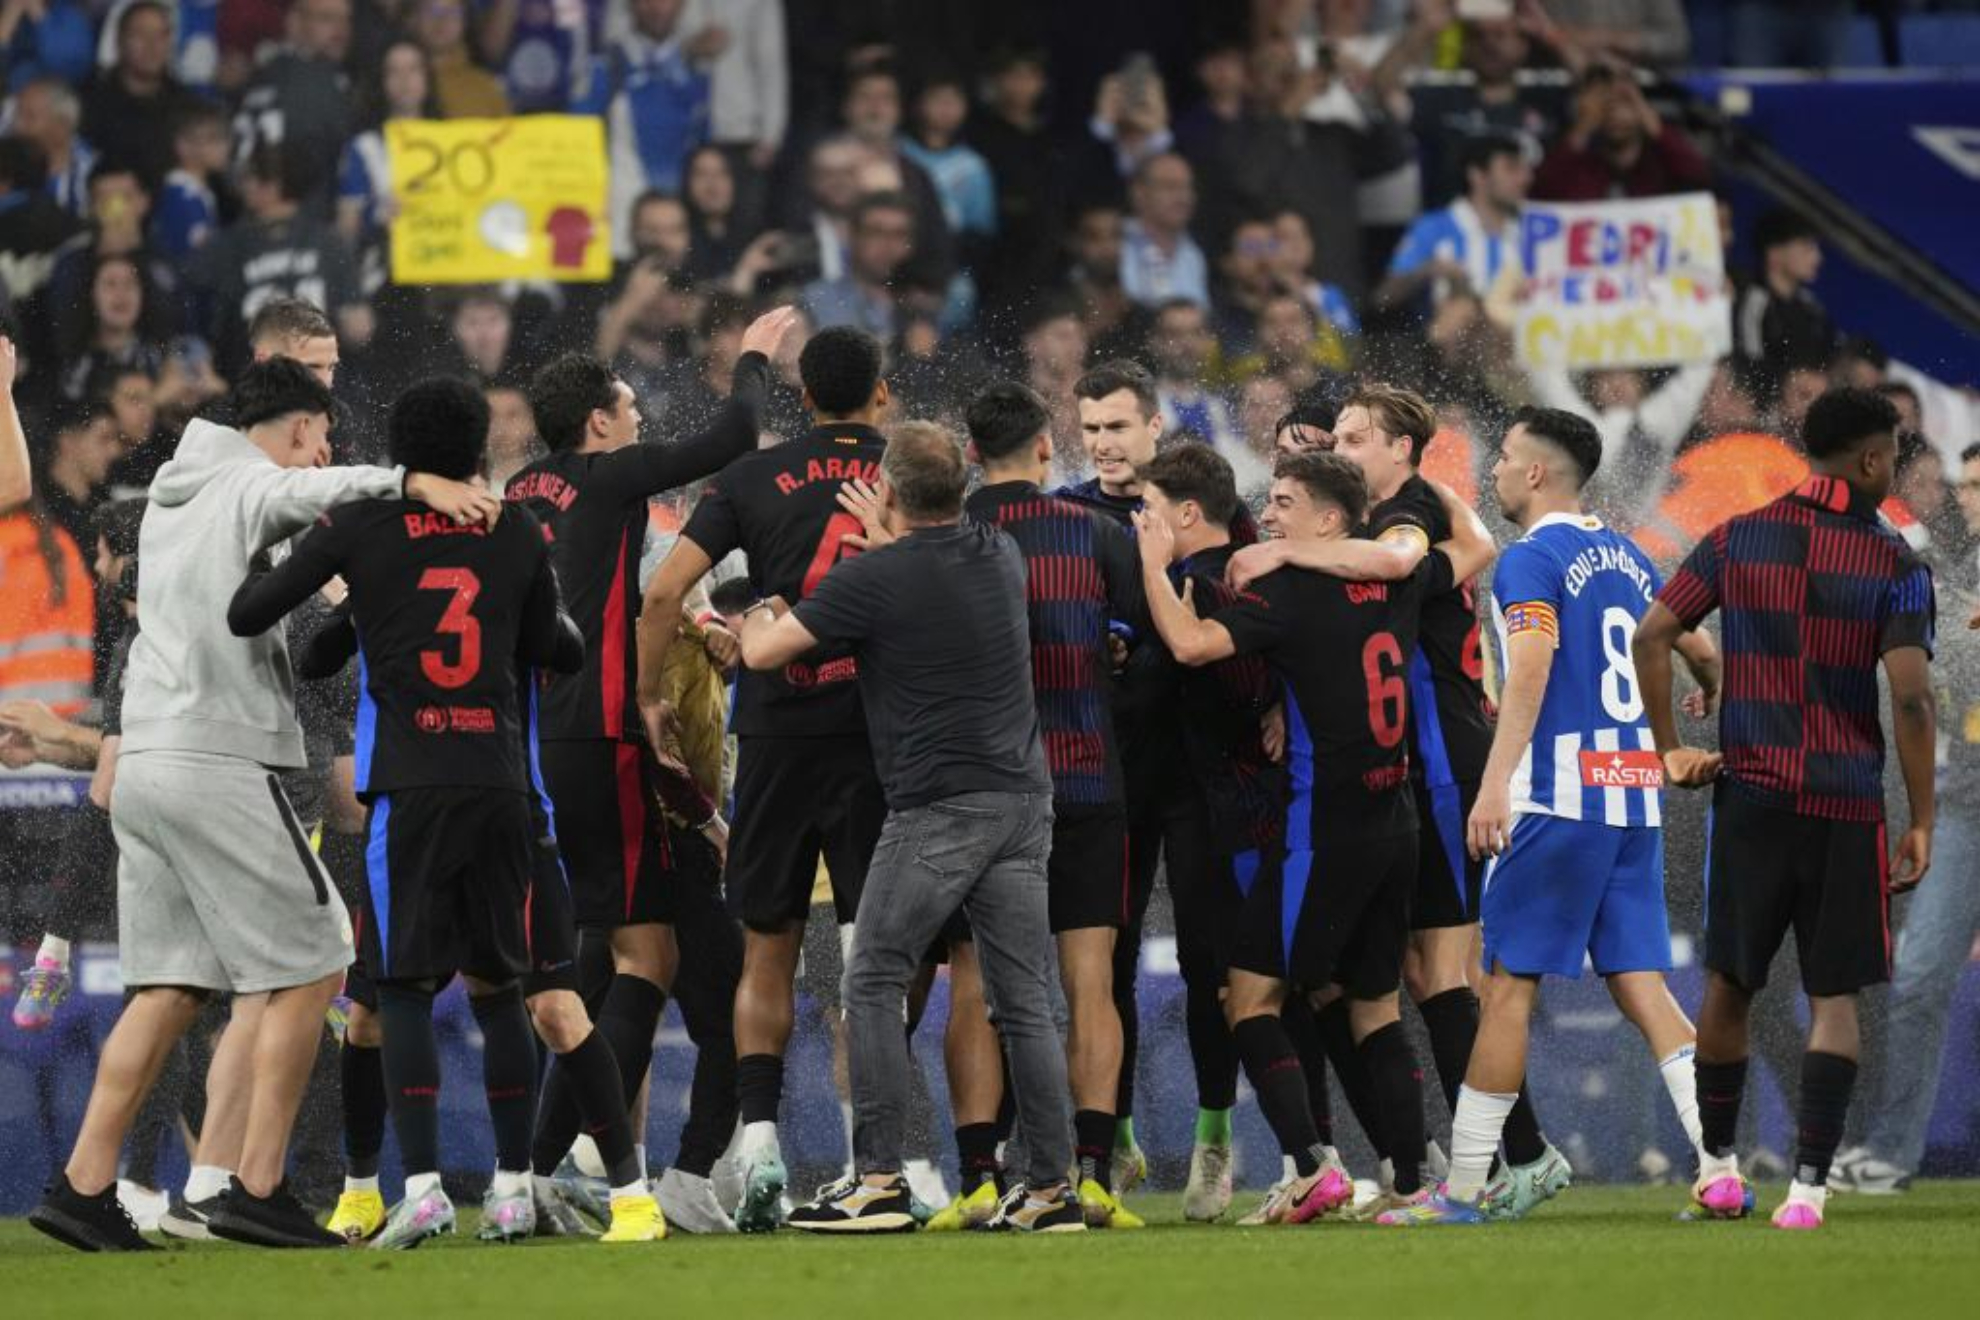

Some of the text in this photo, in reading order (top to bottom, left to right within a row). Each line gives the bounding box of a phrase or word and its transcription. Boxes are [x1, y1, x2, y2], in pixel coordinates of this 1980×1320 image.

[402, 139, 496, 200] 20
[775, 471, 805, 496] R.
[417, 567, 481, 689] 3
[1600, 606, 1645, 723] 8
[1362, 631, 1406, 748] 6
